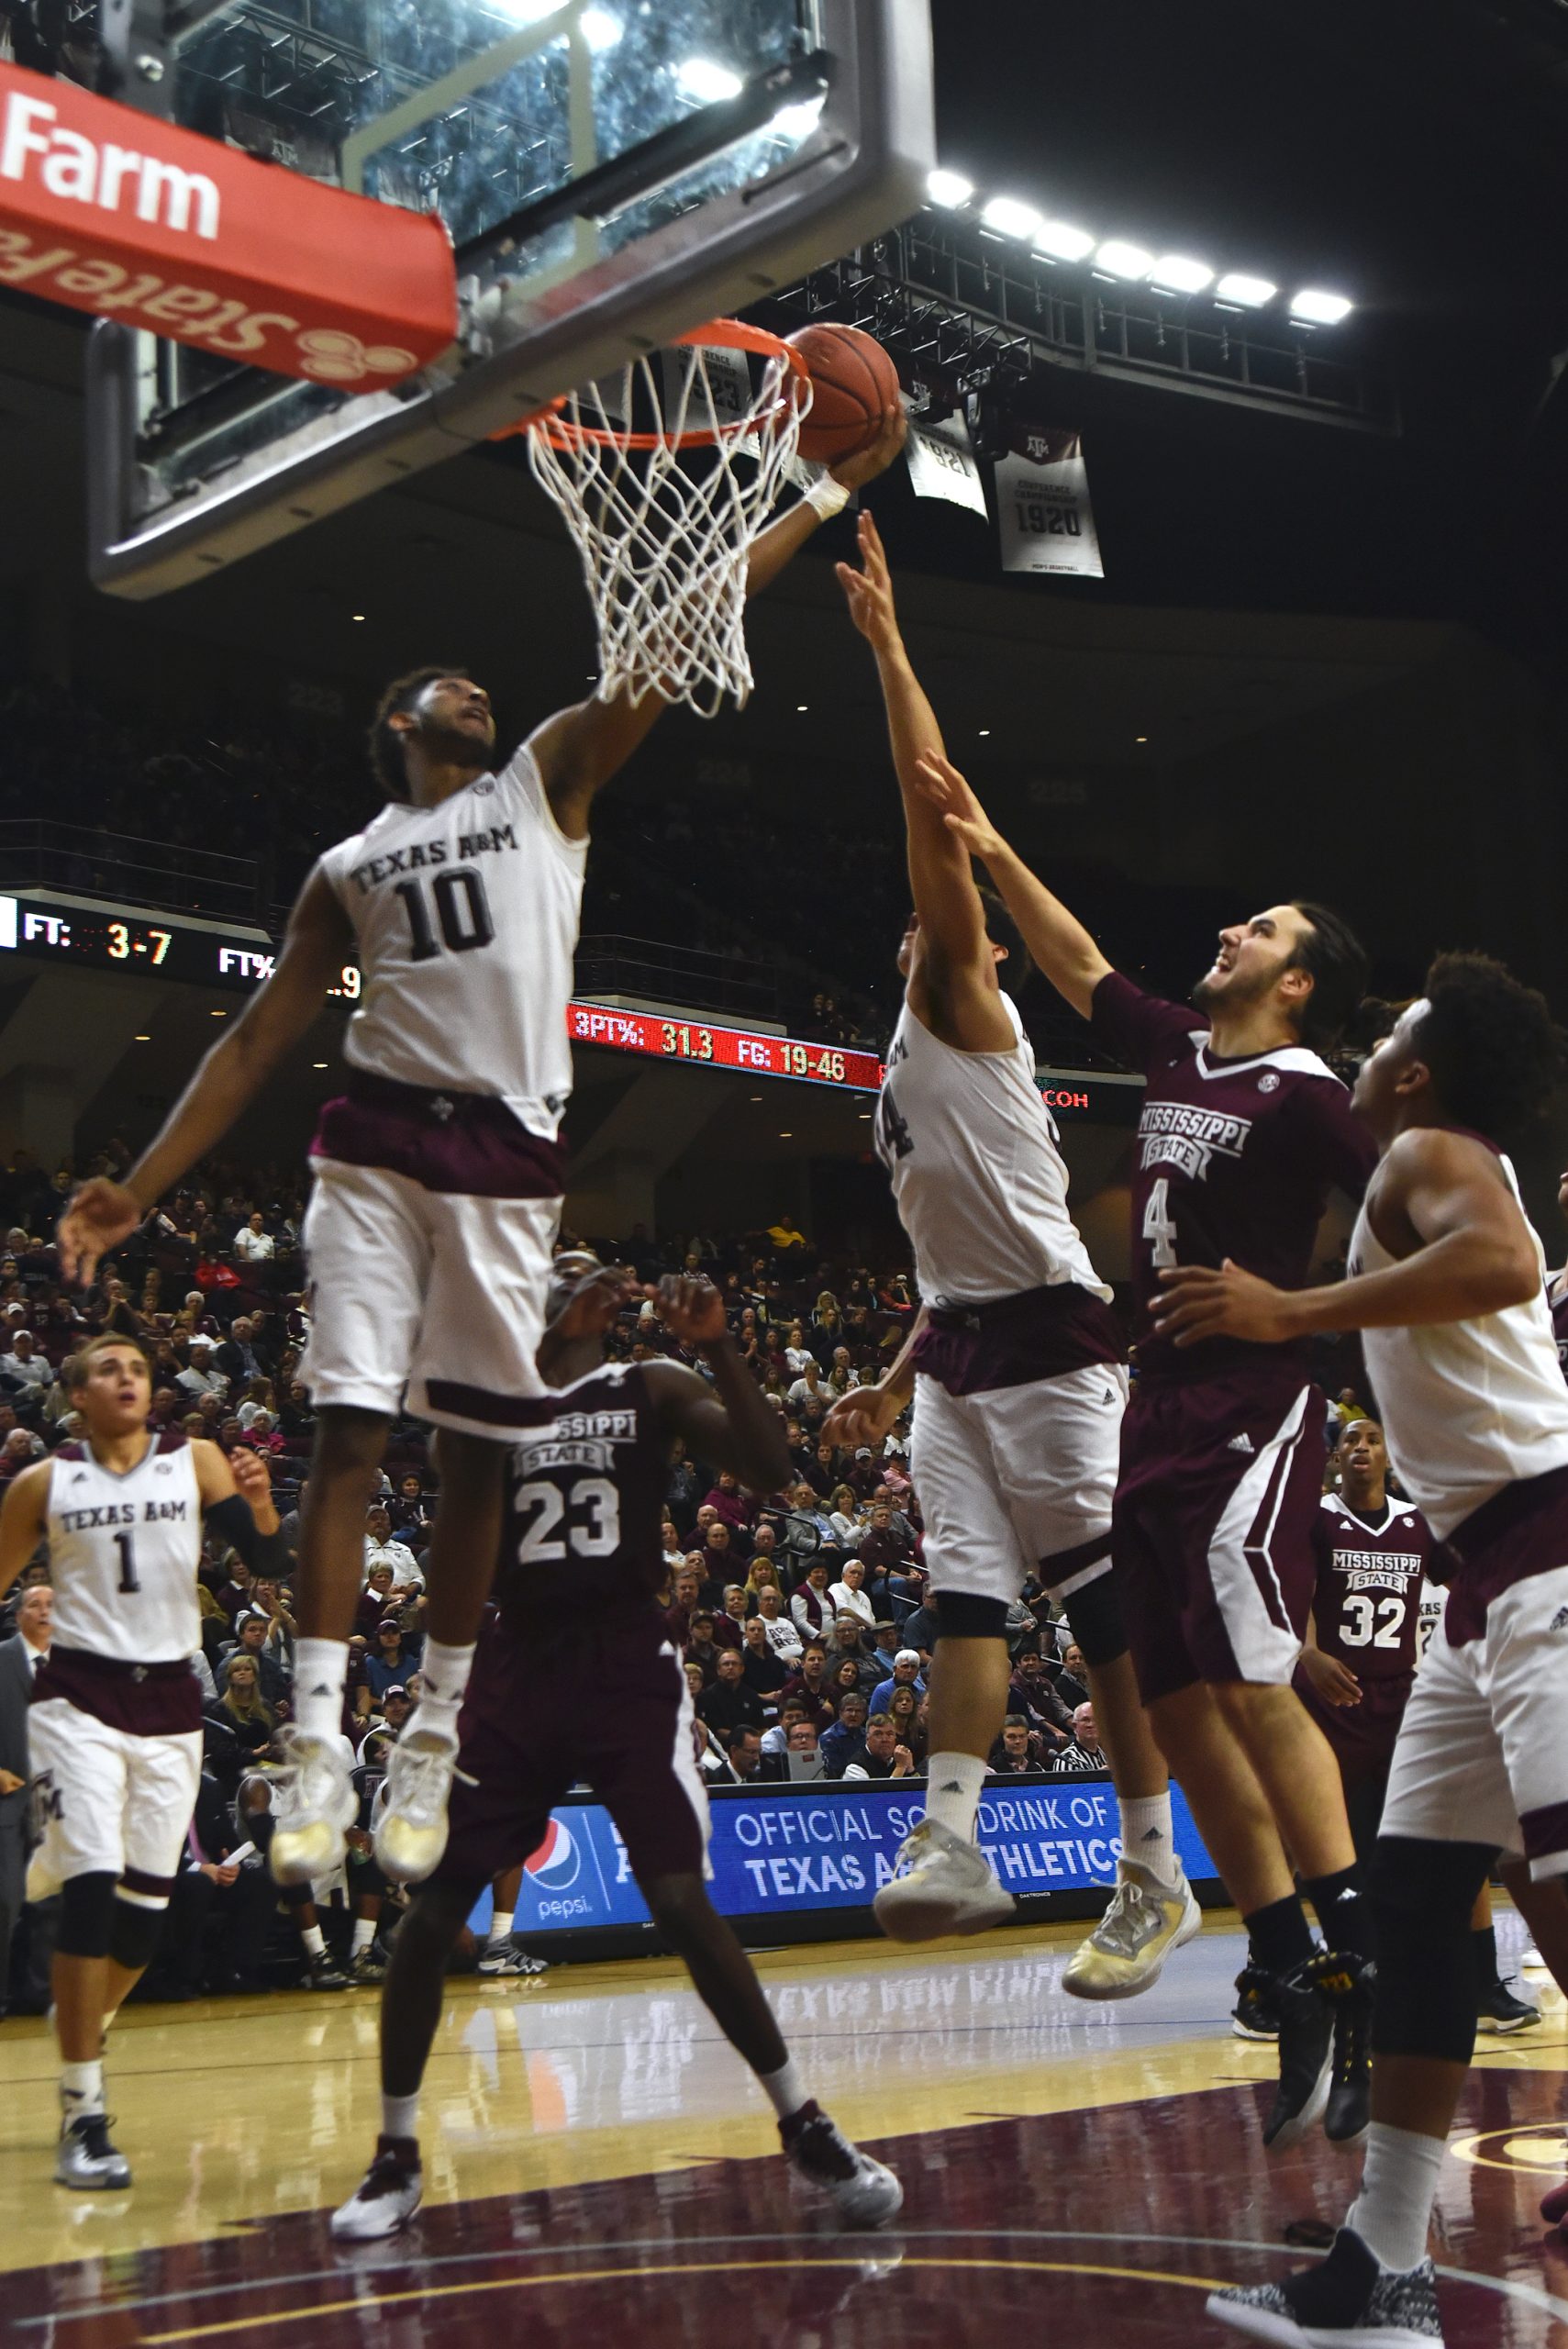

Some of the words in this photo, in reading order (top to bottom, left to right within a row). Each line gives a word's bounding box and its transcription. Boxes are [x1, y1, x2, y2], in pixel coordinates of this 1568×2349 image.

[2, 91, 220, 241] Farm
[55, 260, 300, 351] State
[1015, 503, 1083, 537] 1920
[350, 840, 448, 896] TEXAS
[458, 824, 518, 861] A&M
[24, 912, 72, 947] FT:
[107, 922, 172, 965] 3-7
[395, 865, 496, 963] 10
[575, 1011, 645, 1047] 3PT%:
[661, 1023, 715, 1060] 31.3
[738, 1040, 773, 1068] FG:
[780, 1044, 846, 1082] 19-46
[1041, 1088, 1089, 1109] COH
[1140, 1105, 1251, 1152] MISSISSIPPI
[1149, 1138, 1195, 1168] STATE
[1142, 1177, 1178, 1268] 4
[558, 1414, 638, 1441] SSIPPI
[528, 1443, 597, 1468] STATE
[61, 1504, 135, 1533] TEXAS
[145, 1500, 187, 1523] A&M
[514, 1476, 621, 1565] 23
[114, 1530, 141, 1594] 1
[1332, 1552, 1421, 1574] MISSISSIPPI
[1358, 1573, 1400, 1589] STATE
[1339, 1594, 1407, 1649] 32
[1418, 1602, 1441, 1617] XAS
[735, 1808, 883, 1847] OFFICIAL
[887, 1805, 926, 1838] SO
[978, 1798, 1069, 1833] DRINK
[1070, 1796, 1107, 1828] OF
[744, 1854, 866, 1897] TEXAS
[980, 1837, 1124, 1881] THLETICS
[538, 1895, 588, 1920] pepsi
